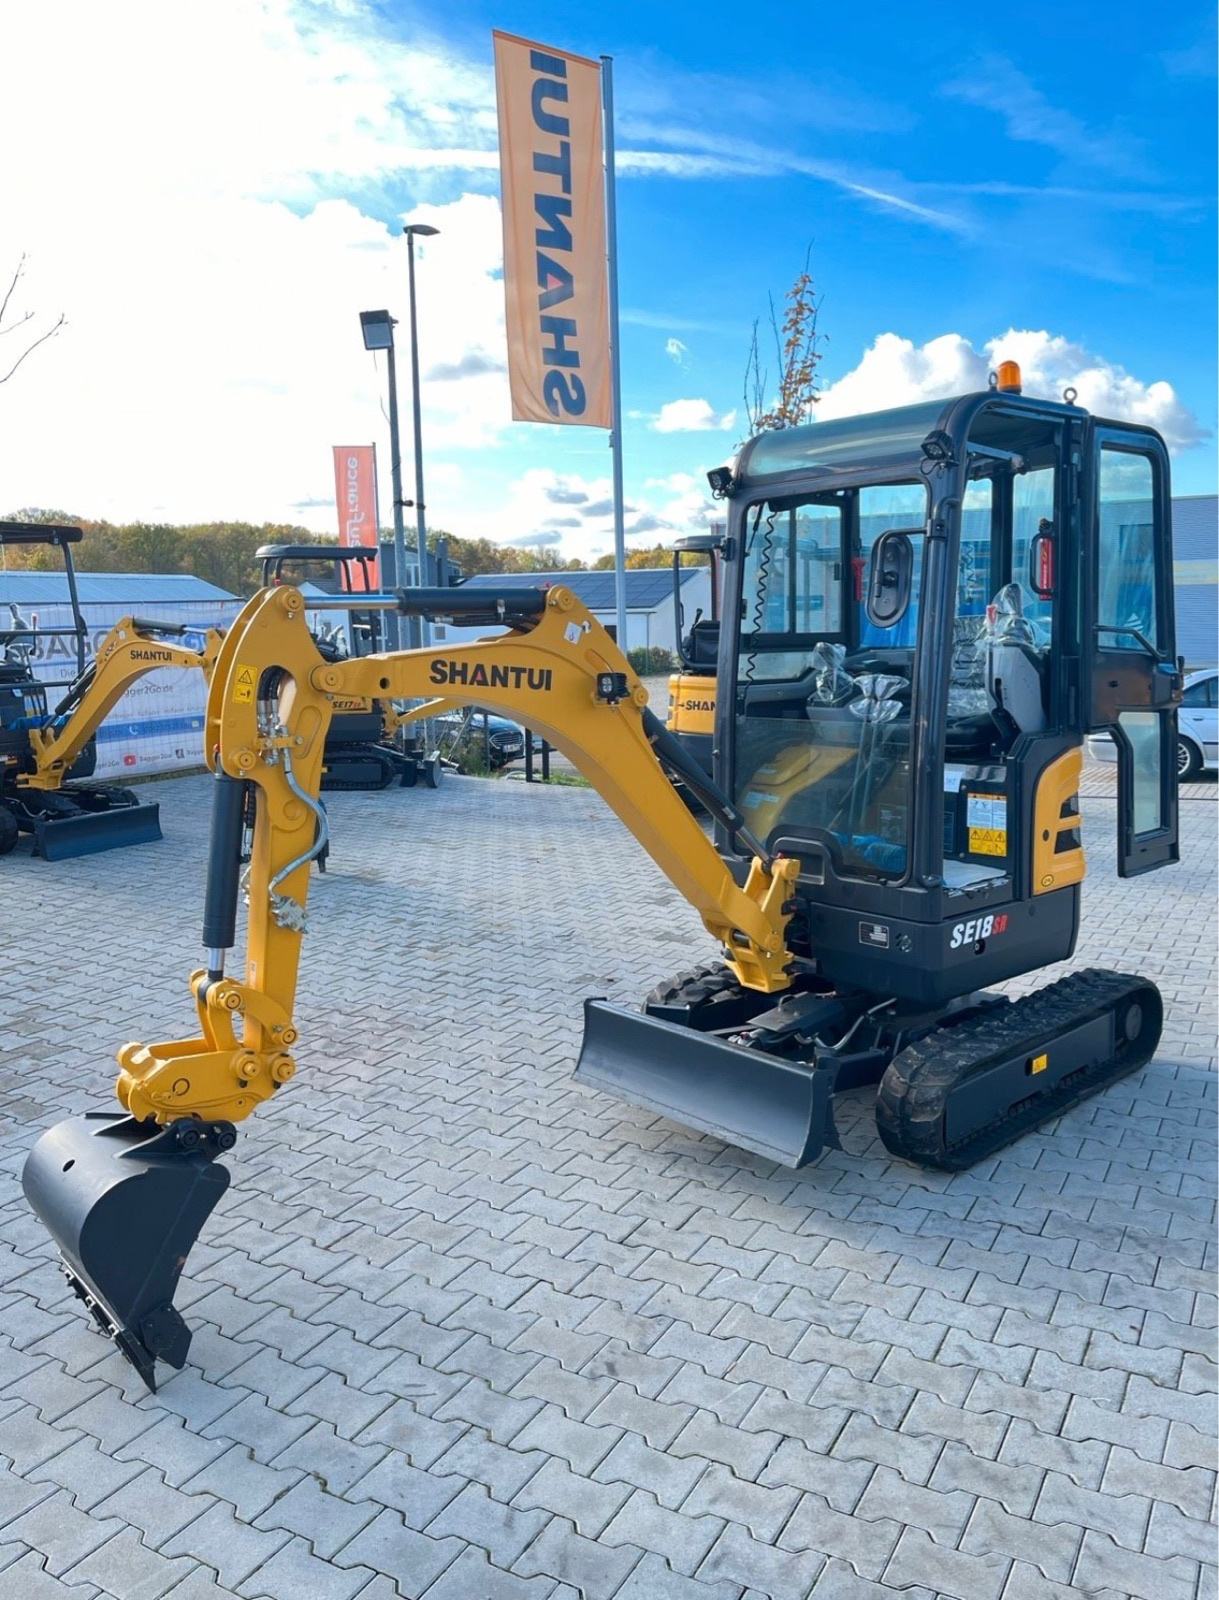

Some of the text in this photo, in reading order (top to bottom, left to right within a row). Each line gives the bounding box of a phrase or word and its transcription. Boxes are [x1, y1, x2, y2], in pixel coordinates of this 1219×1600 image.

[130, 650, 172, 661] SHANTUI
[429, 659, 552, 691] SHANTUI
[686, 700, 716, 711] SHAN
